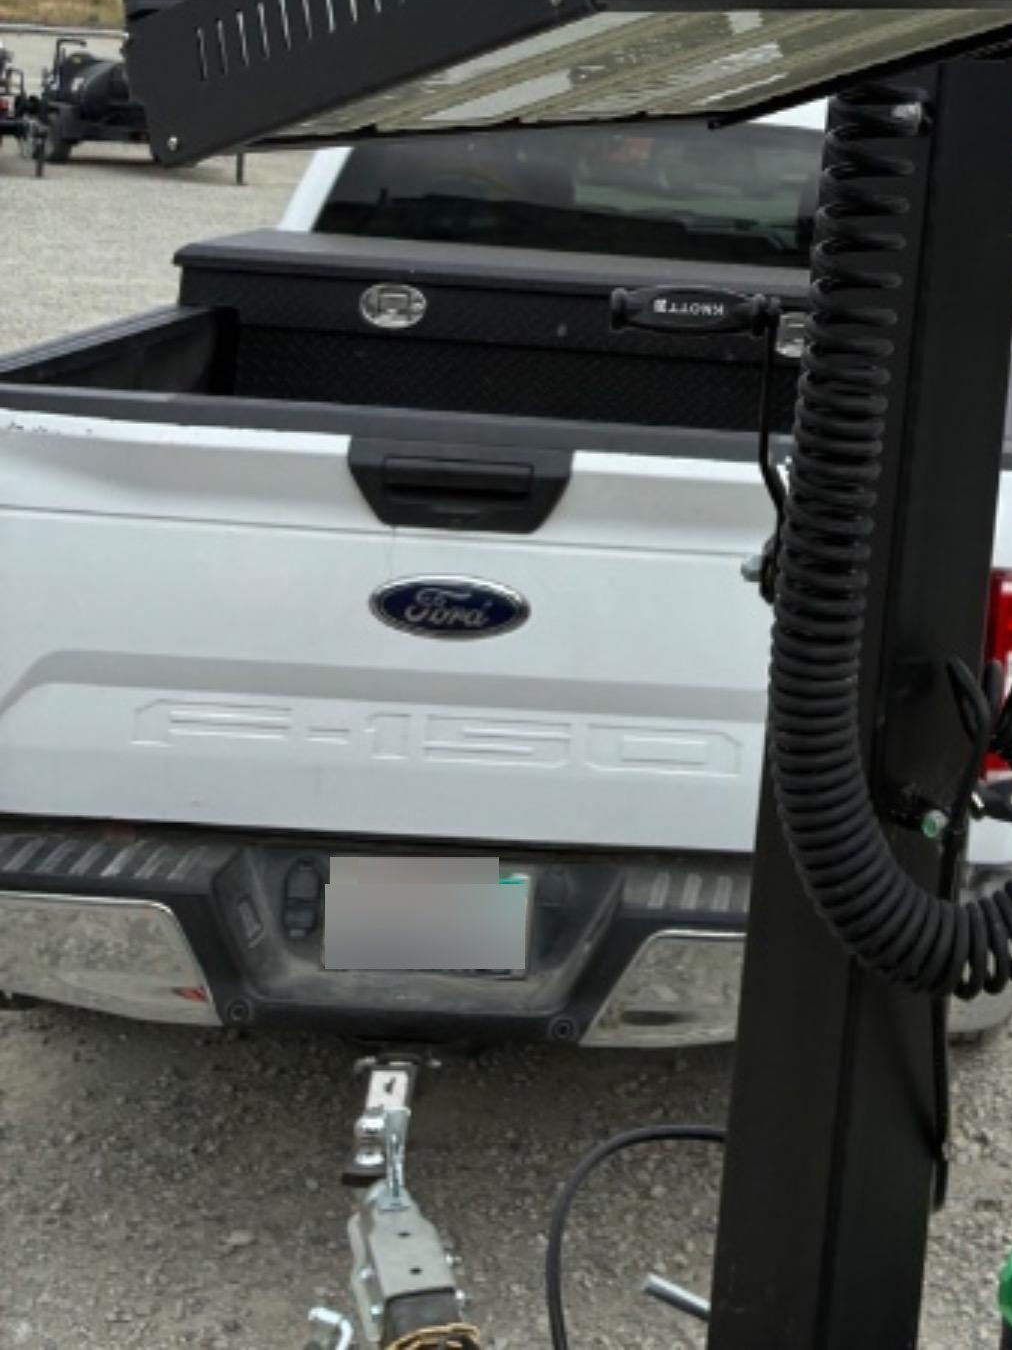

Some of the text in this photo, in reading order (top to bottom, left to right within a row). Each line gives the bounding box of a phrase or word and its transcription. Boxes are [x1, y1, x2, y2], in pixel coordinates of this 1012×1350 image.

[668, 302, 724, 315] KNOTT
[404, 588, 493, 627] Ford
[132, 698, 742, 778] F-150
